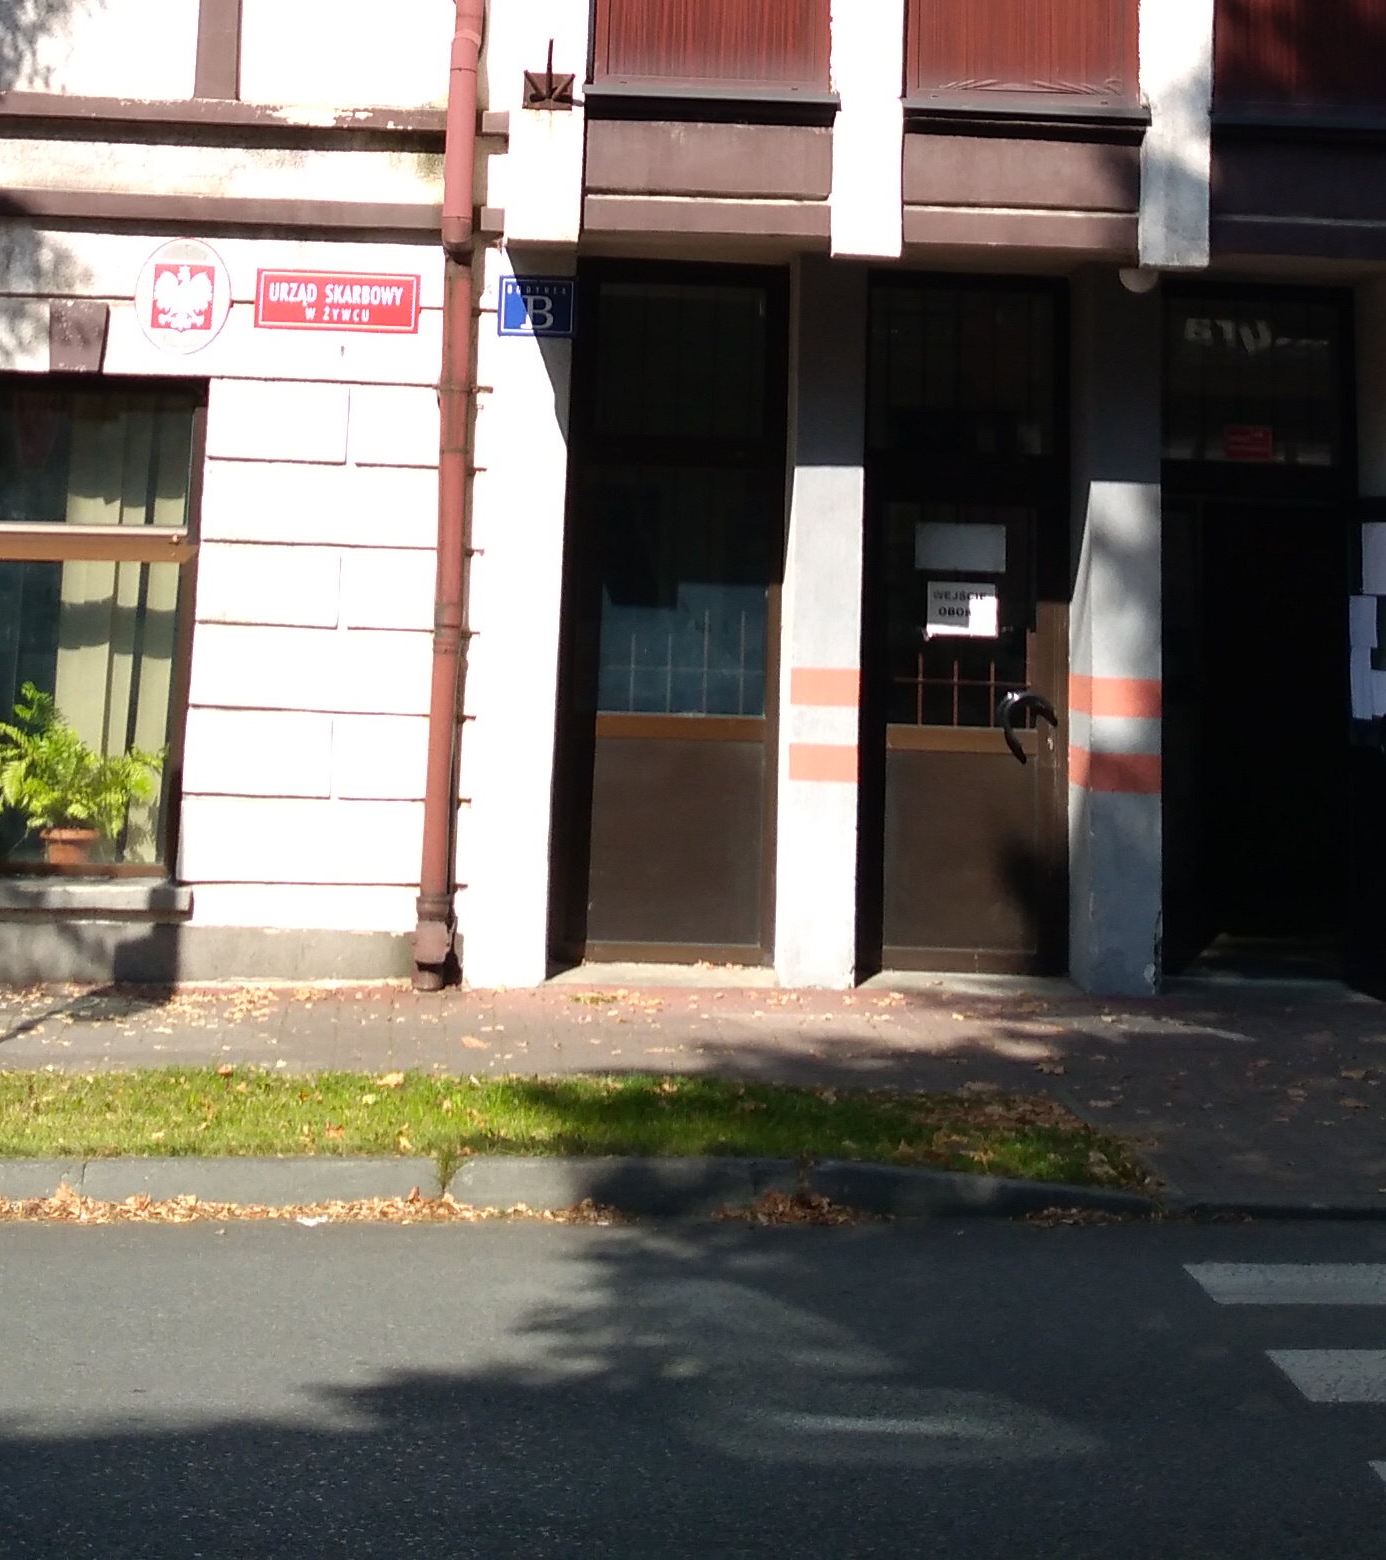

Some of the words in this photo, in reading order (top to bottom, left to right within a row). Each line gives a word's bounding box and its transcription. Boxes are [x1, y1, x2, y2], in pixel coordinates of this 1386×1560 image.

[269, 282, 317, 306] URZĄD
[325, 283, 404, 306] SKARBOWY
[305, 307, 316, 320] W
[322, 305, 370, 323] ŻYWCU
[520, 295, 554, 329] B
